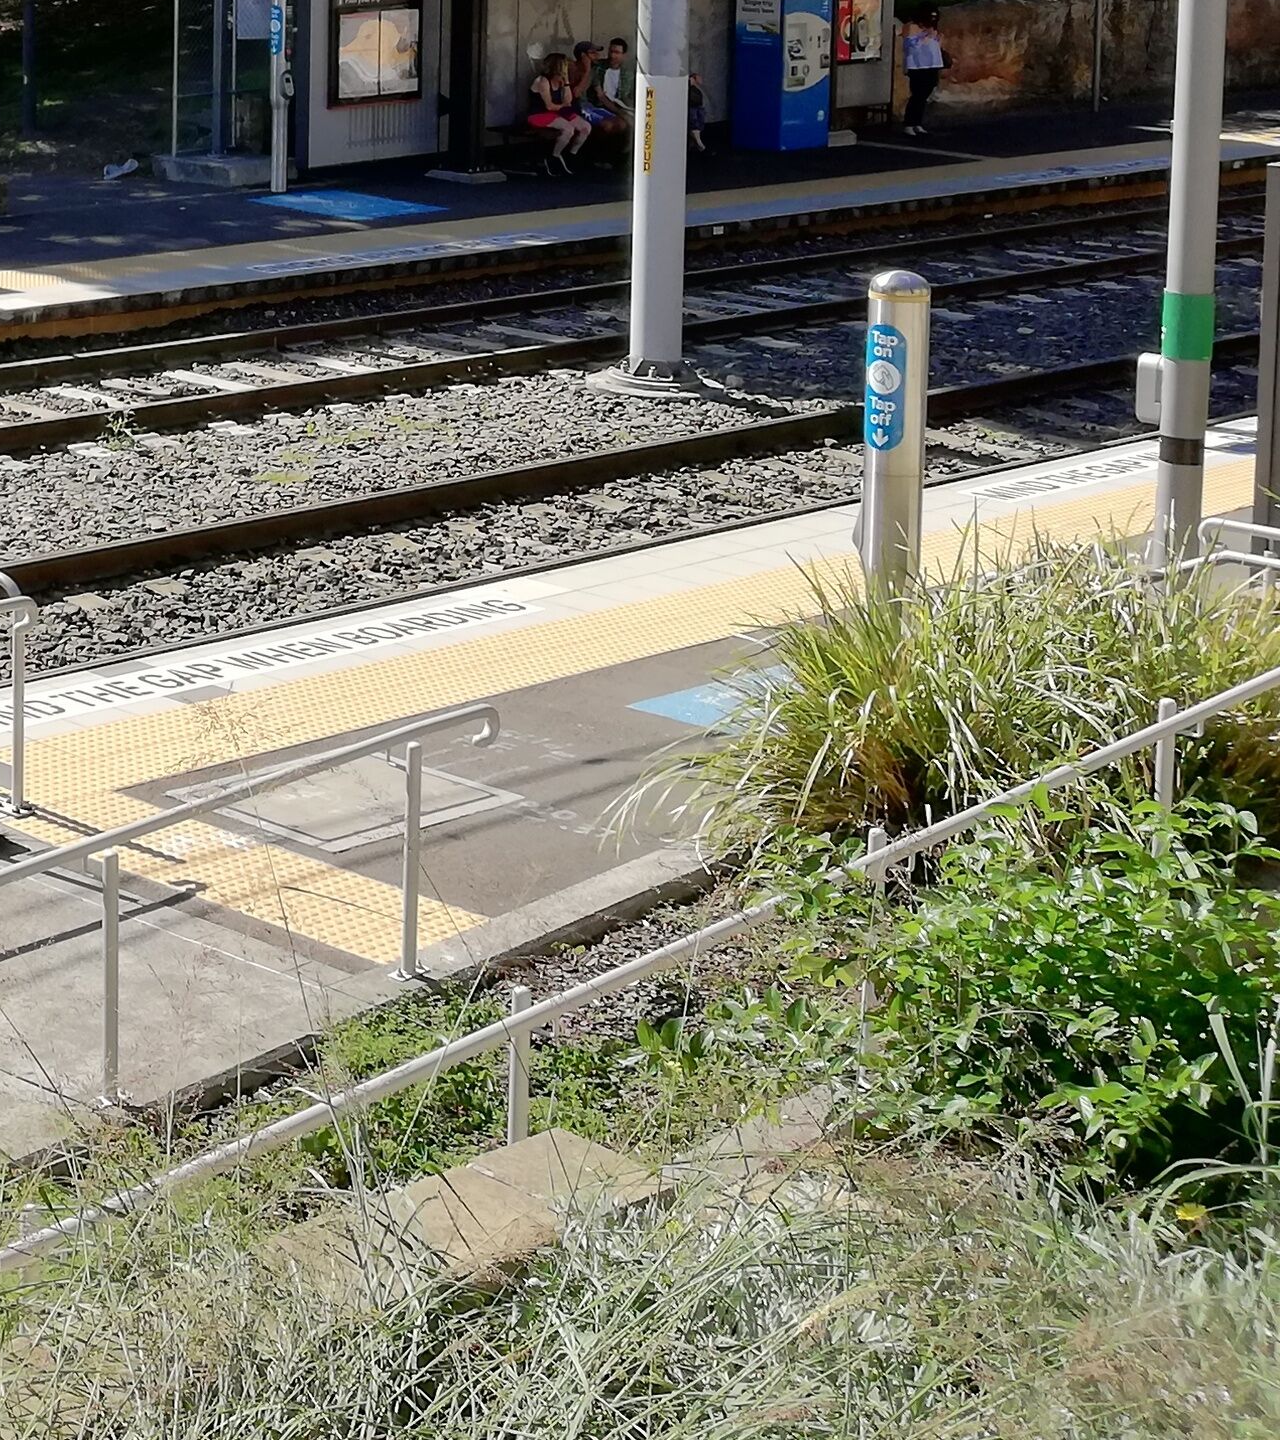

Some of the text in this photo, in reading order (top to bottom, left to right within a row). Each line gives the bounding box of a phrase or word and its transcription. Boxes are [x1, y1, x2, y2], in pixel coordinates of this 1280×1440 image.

[871, 330, 899, 347] Tap
[873, 346, 892, 357] on
[869, 395, 896, 412] Tap
[869, 413, 892, 426] off
[971, 460, 1149, 500] MIND THE GAP
[48, 681, 154, 707] THE
[137, 663, 225, 689] GAP
[211, 637, 353, 671] WHEN
[333, 599, 527, 646] BOARDING
